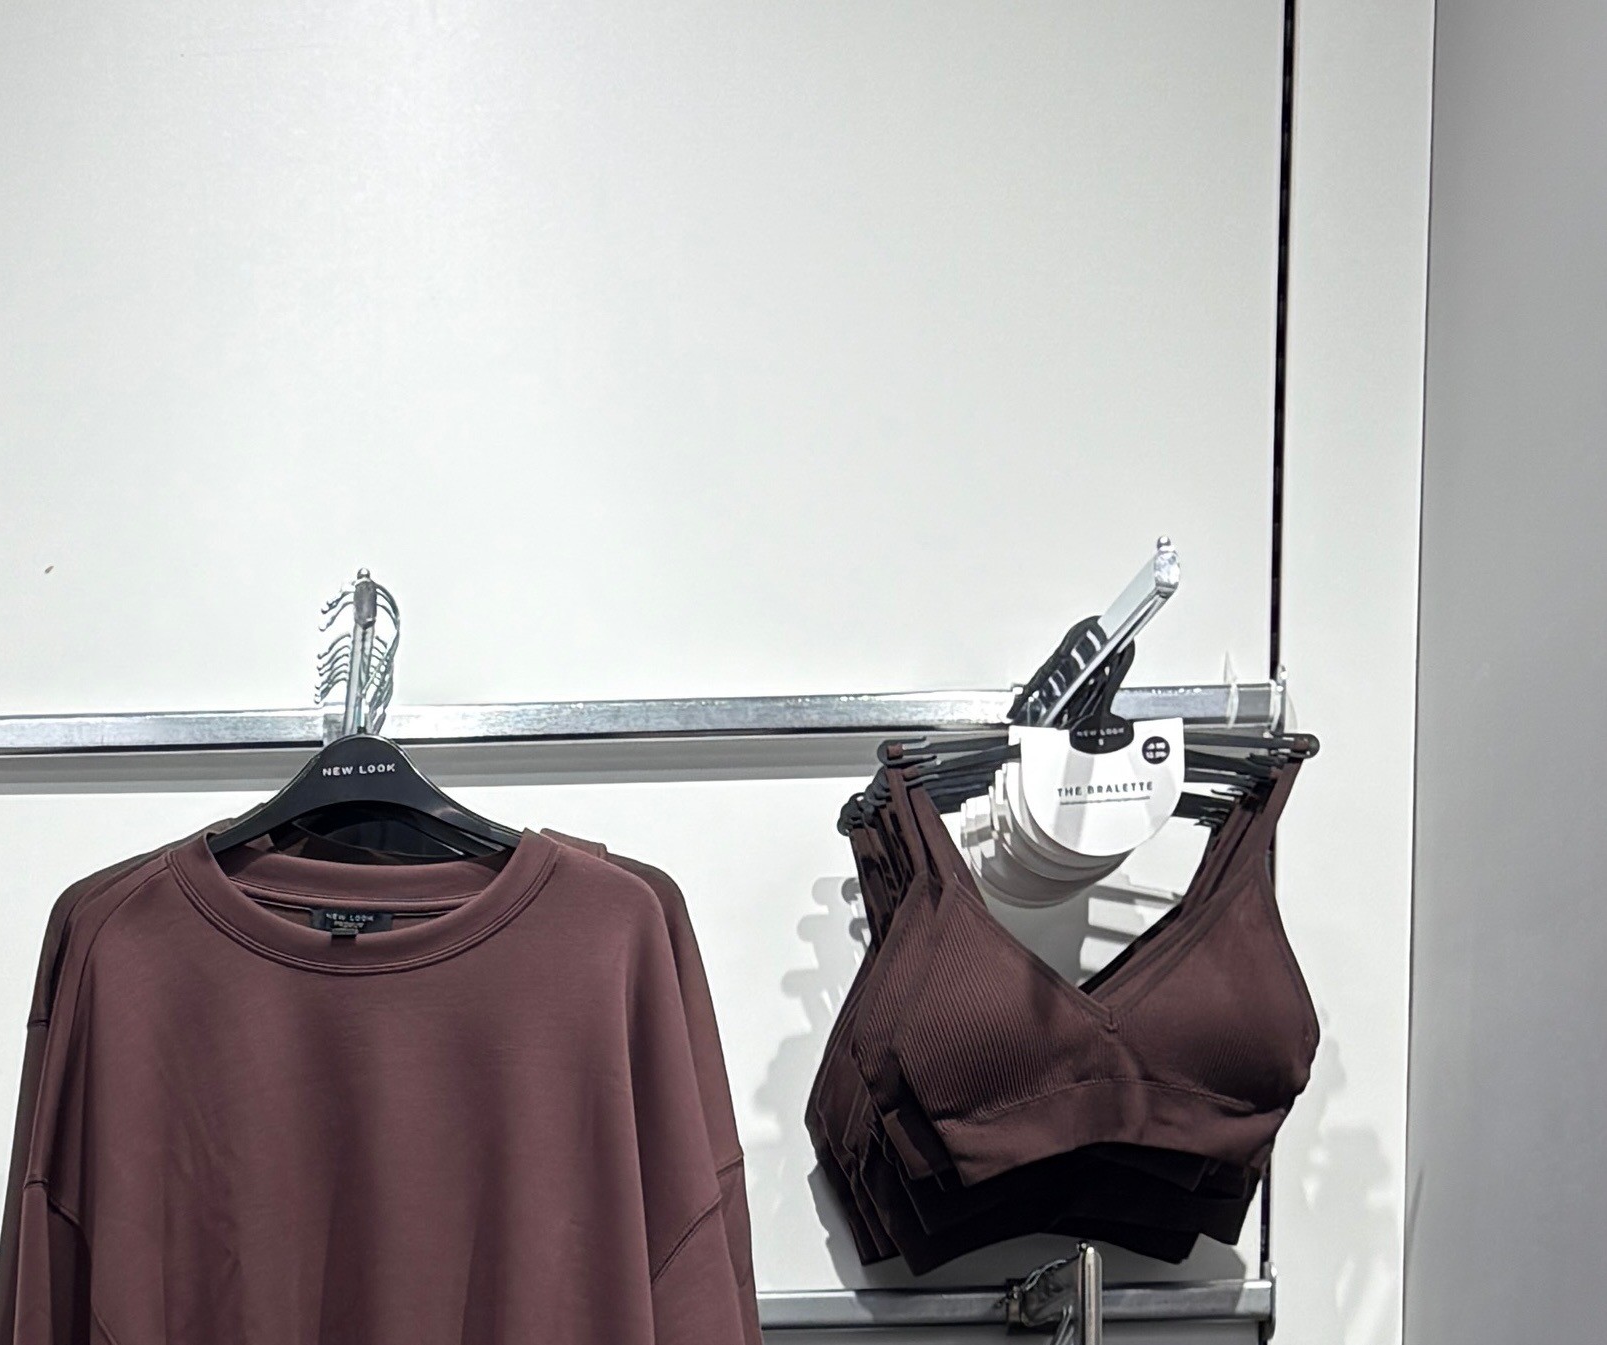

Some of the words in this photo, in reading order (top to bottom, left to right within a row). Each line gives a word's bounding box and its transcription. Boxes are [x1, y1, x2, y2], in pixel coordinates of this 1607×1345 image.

[322, 766, 353, 776] NEW
[359, 763, 395, 774] LOOK
[1058, 786, 1082, 797] THE
[1087, 781, 1153, 795] BRALETTE
